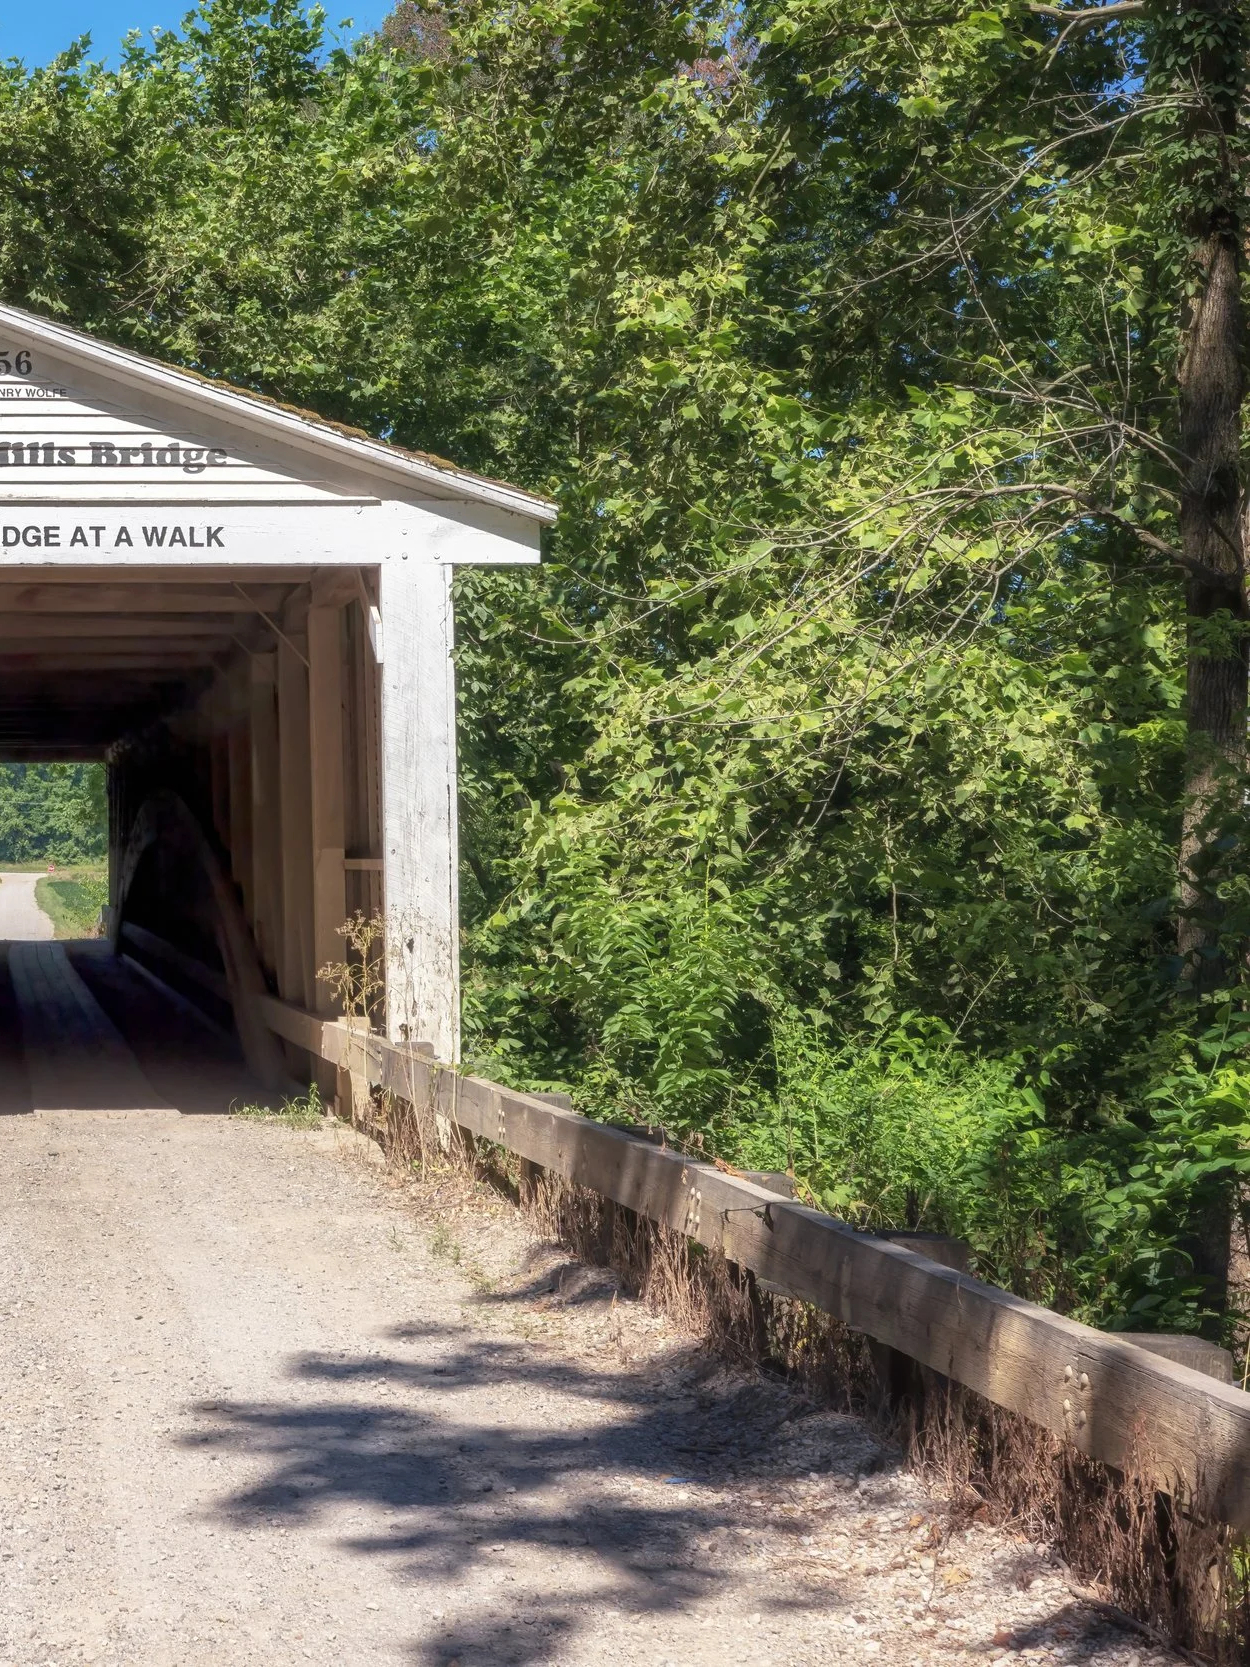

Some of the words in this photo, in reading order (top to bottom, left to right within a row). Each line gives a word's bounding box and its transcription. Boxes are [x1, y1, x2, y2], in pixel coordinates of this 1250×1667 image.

[26, 388, 67, 397] WOLFE
[89, 441, 227, 474] Bridge
[70, 526, 106, 547] AT
[114, 526, 134, 547] A
[142, 526, 225, 547] WALK
